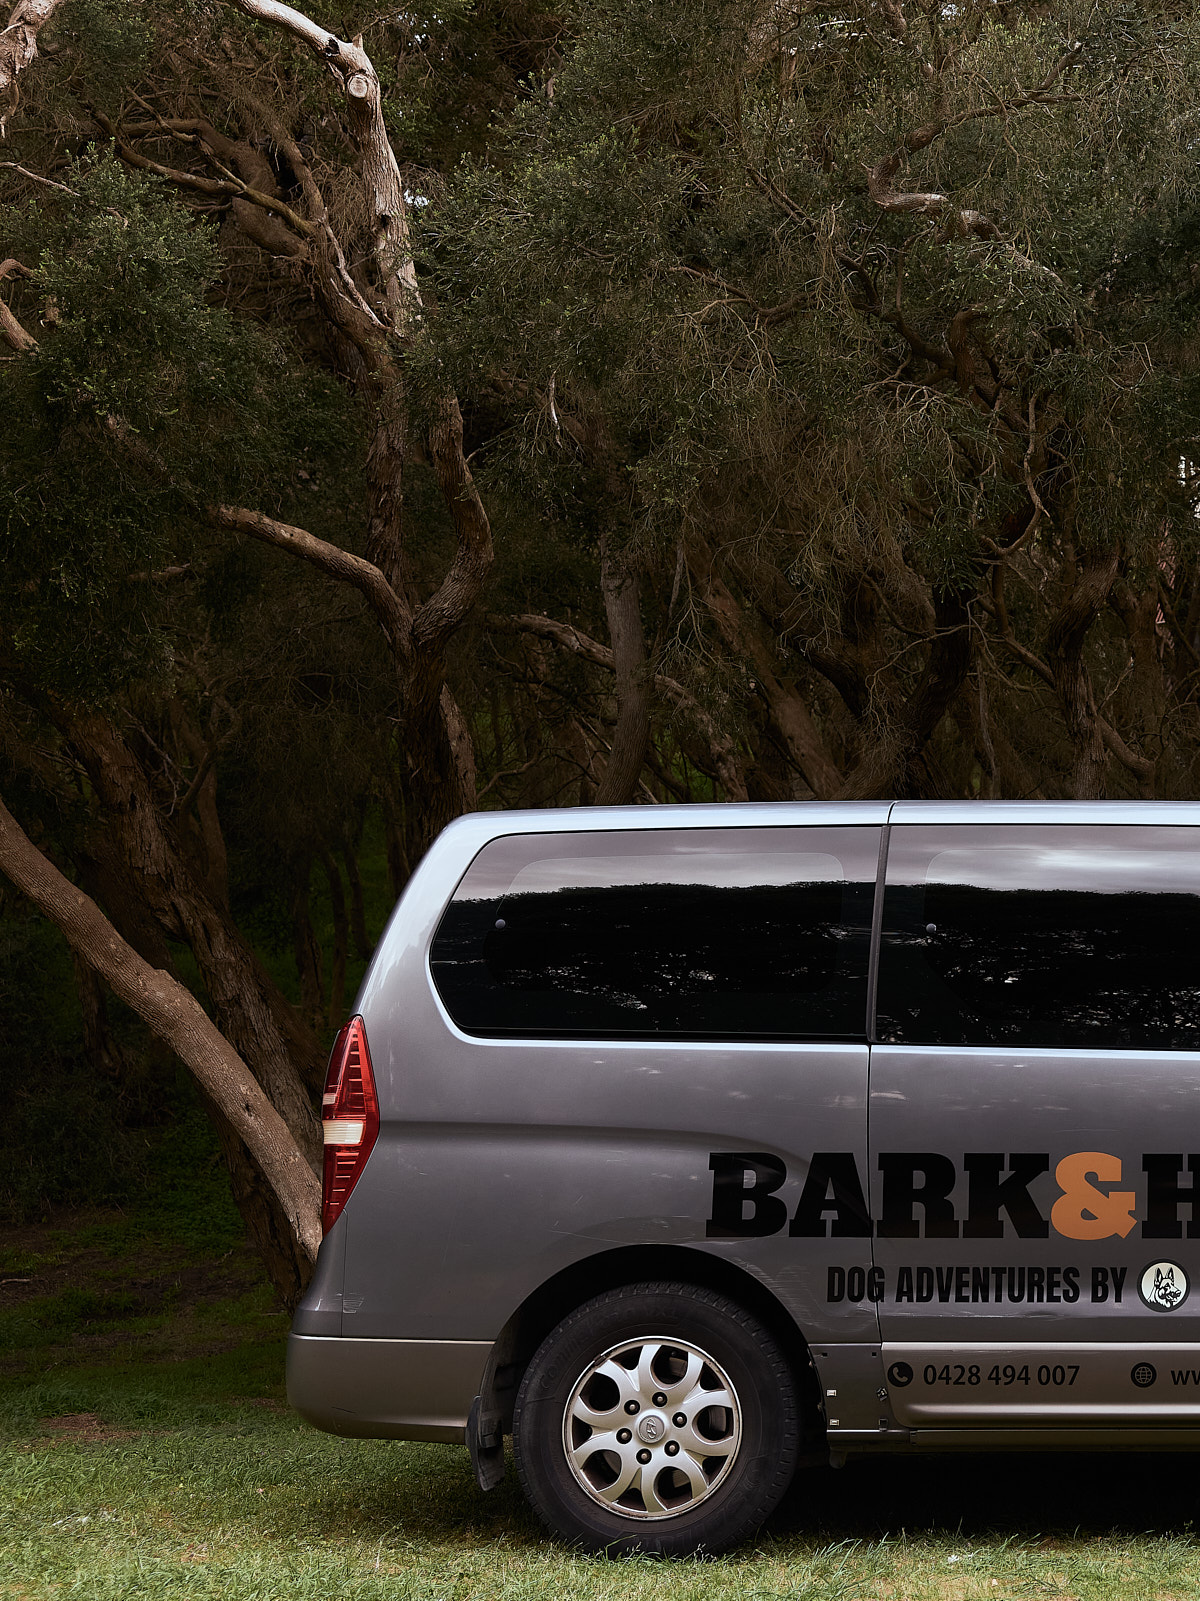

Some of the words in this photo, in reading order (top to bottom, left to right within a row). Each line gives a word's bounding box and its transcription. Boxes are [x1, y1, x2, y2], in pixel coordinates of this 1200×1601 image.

[827, 1266, 886, 1304] DOG
[895, 1266, 1081, 1304] ADVENTURES
[1091, 1266, 1128, 1303] BY
[923, 1364, 982, 1387] 0428
[987, 1364, 1031, 1386] 494
[1037, 1364, 1081, 1386] 007
